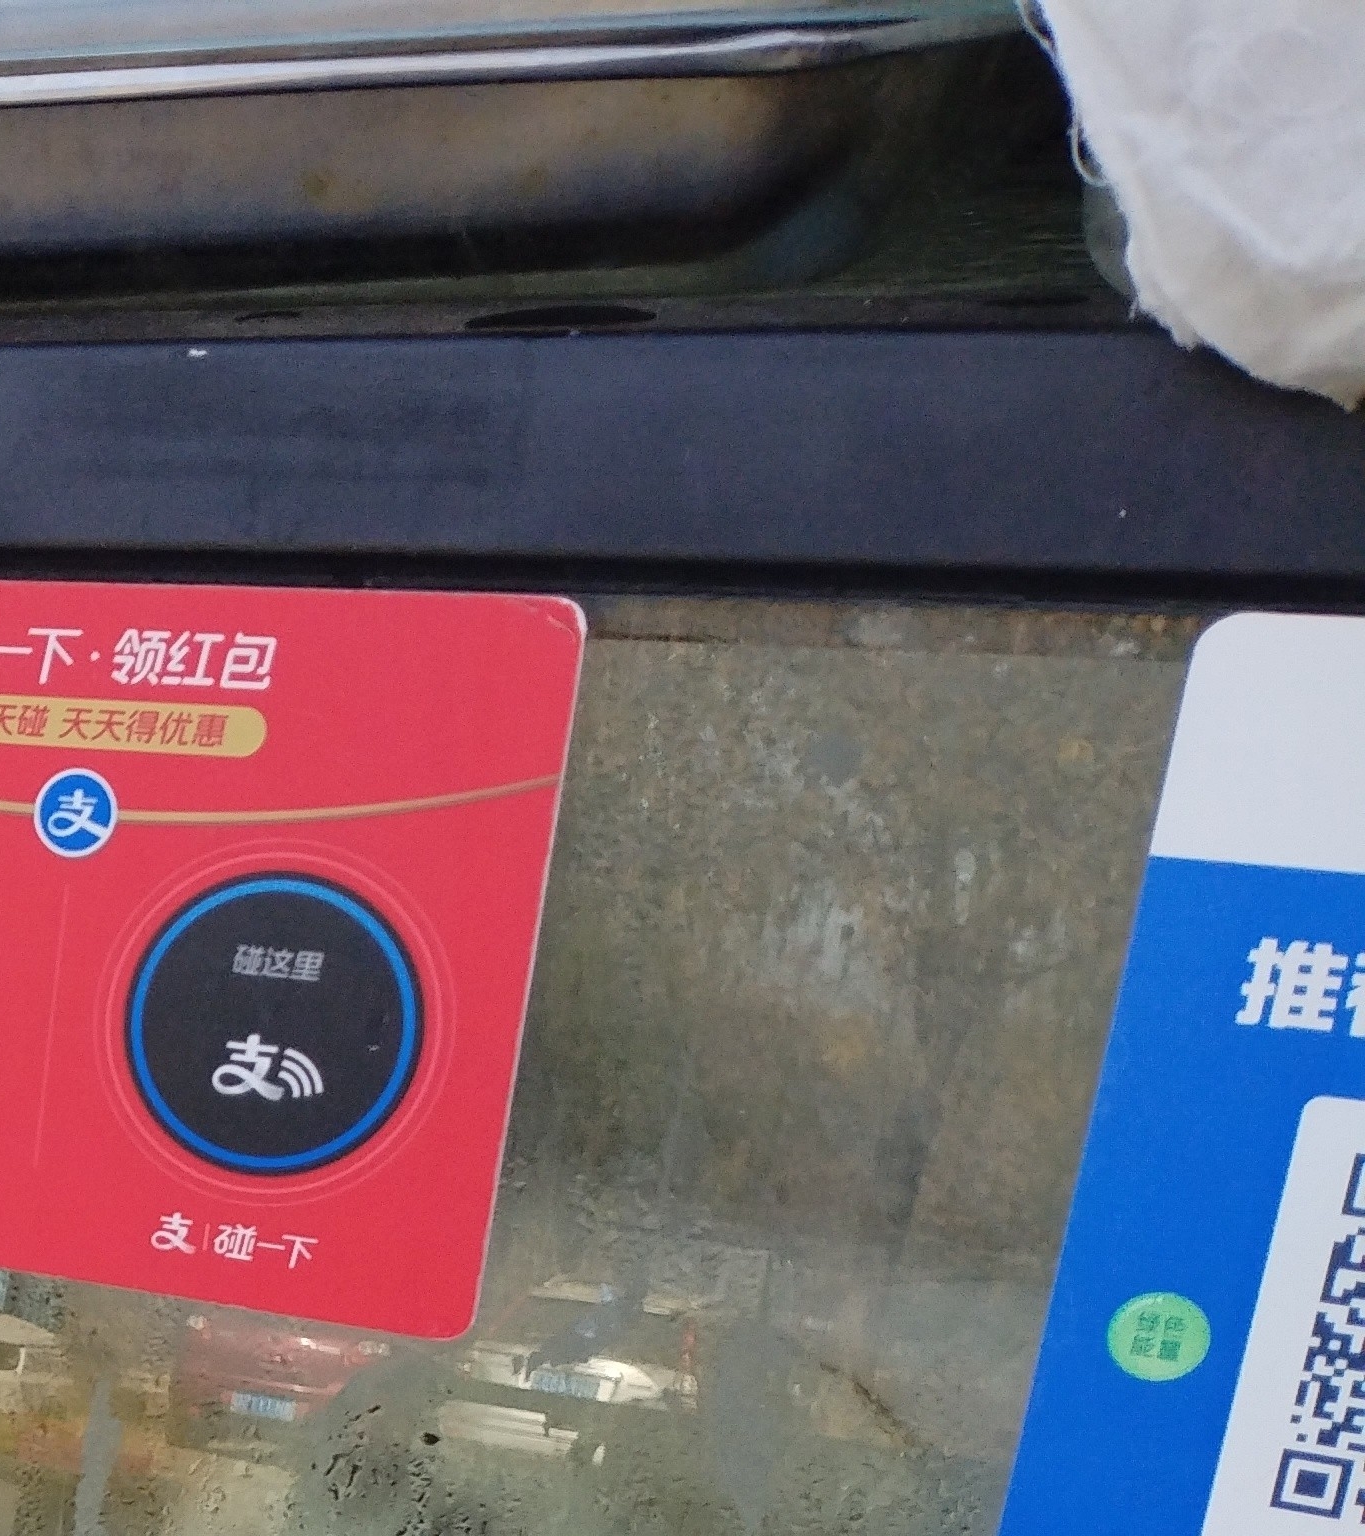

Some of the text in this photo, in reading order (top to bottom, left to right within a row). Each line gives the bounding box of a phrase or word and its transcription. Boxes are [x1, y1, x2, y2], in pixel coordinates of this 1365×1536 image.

[58, 706, 230, 748] 天天得优惠
[231, 943, 325, 982] 碰这里
[1233, 935, 1365, 1038] 推
[213, 1222, 320, 1270] 碰一下
